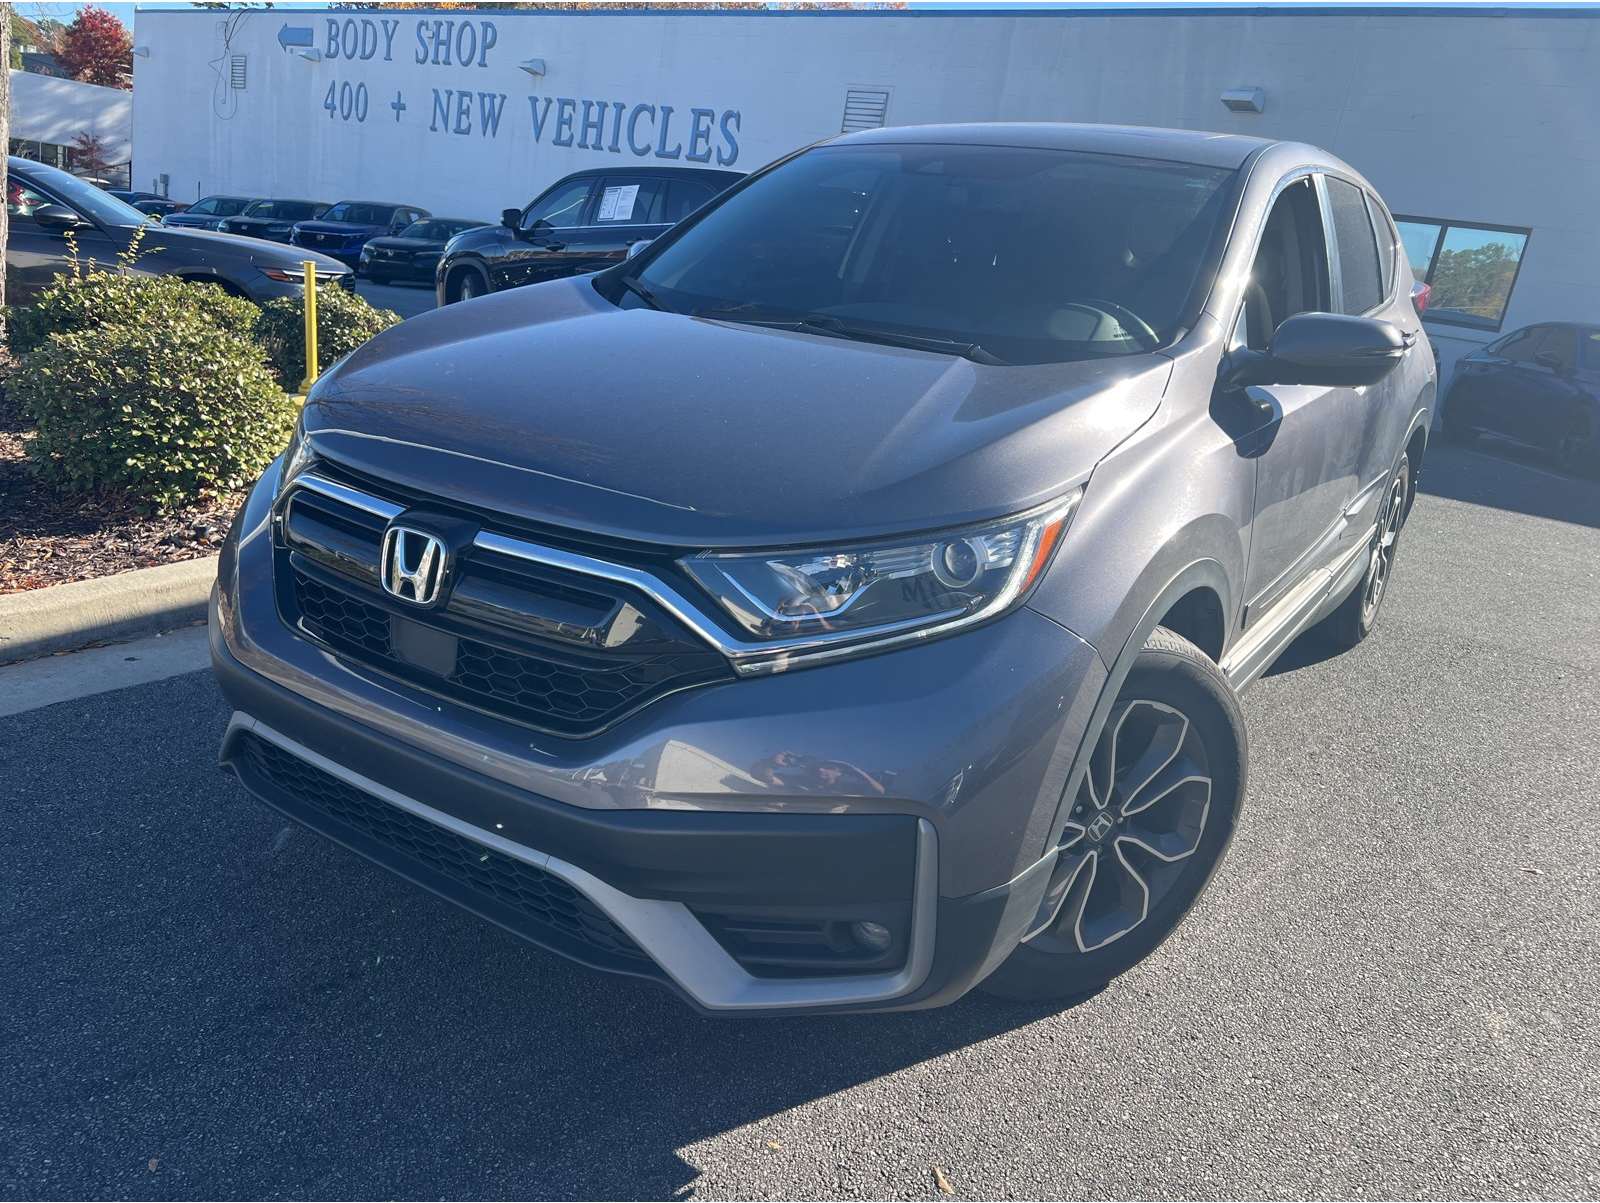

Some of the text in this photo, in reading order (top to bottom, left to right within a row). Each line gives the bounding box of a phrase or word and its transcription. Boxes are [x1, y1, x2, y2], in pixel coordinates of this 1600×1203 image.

[325, 18, 497, 67] BODY SHOP
[324, 80, 368, 122] 400
[429, 88, 507, 138] NEW
[528, 95, 741, 166] VEHICLES
